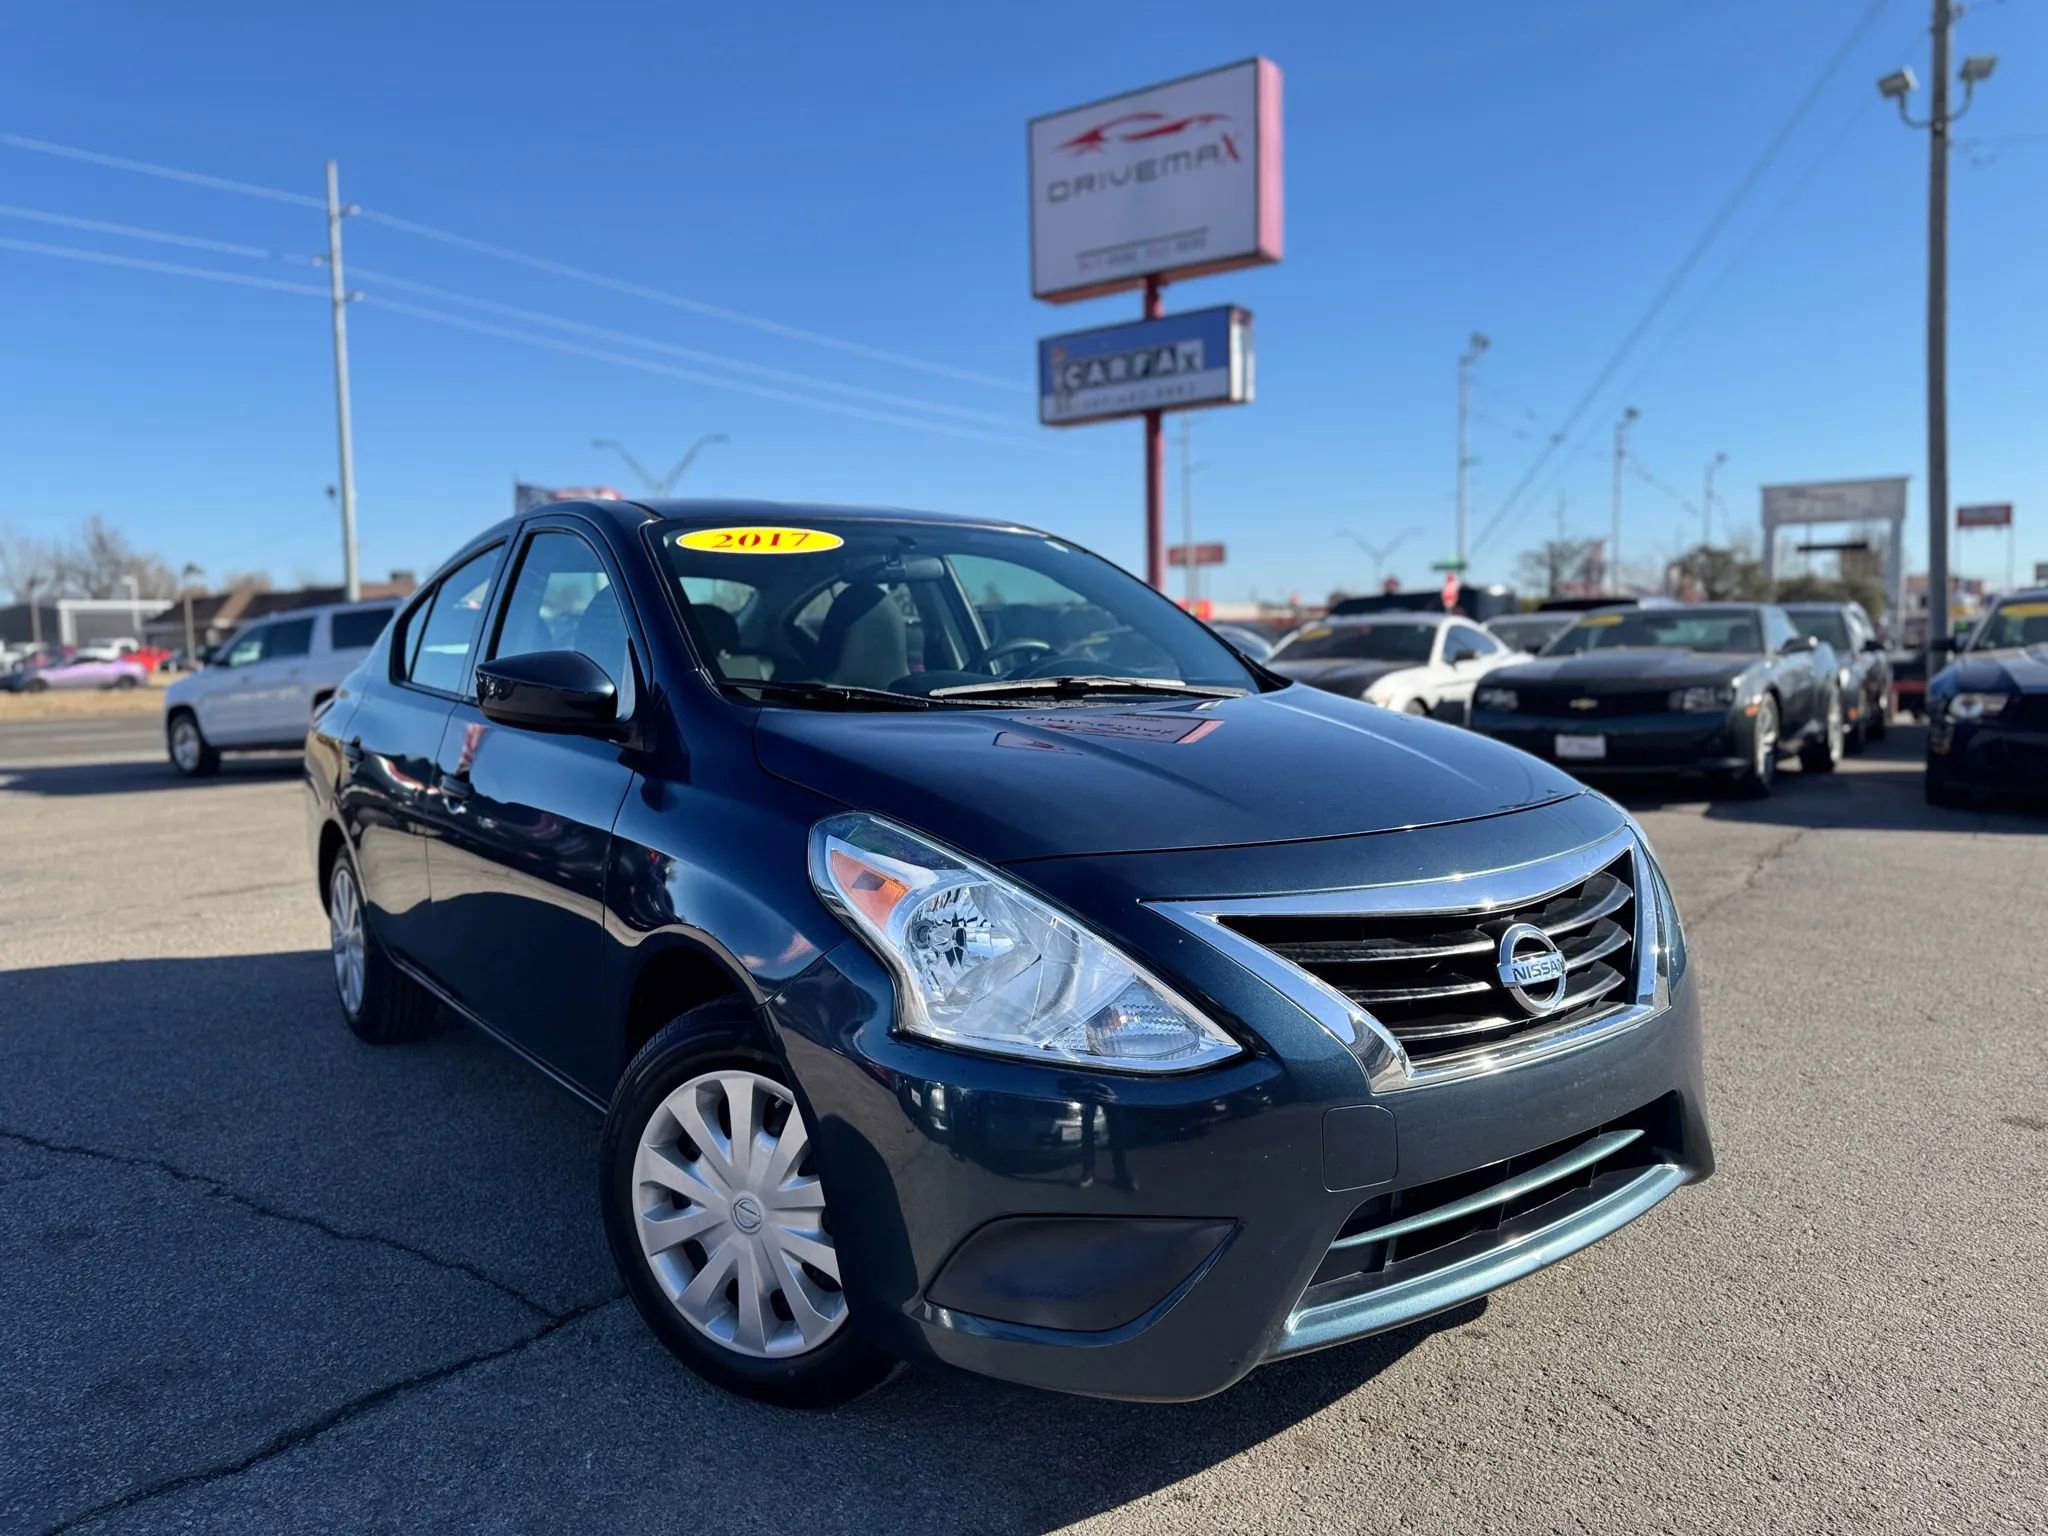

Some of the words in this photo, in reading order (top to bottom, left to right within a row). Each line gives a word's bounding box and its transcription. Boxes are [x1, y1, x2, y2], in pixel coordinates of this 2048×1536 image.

[1064, 343, 1201, 388] CARFAX
[712, 533, 810, 548] 2017
[1512, 957, 1566, 981] NISSAN
